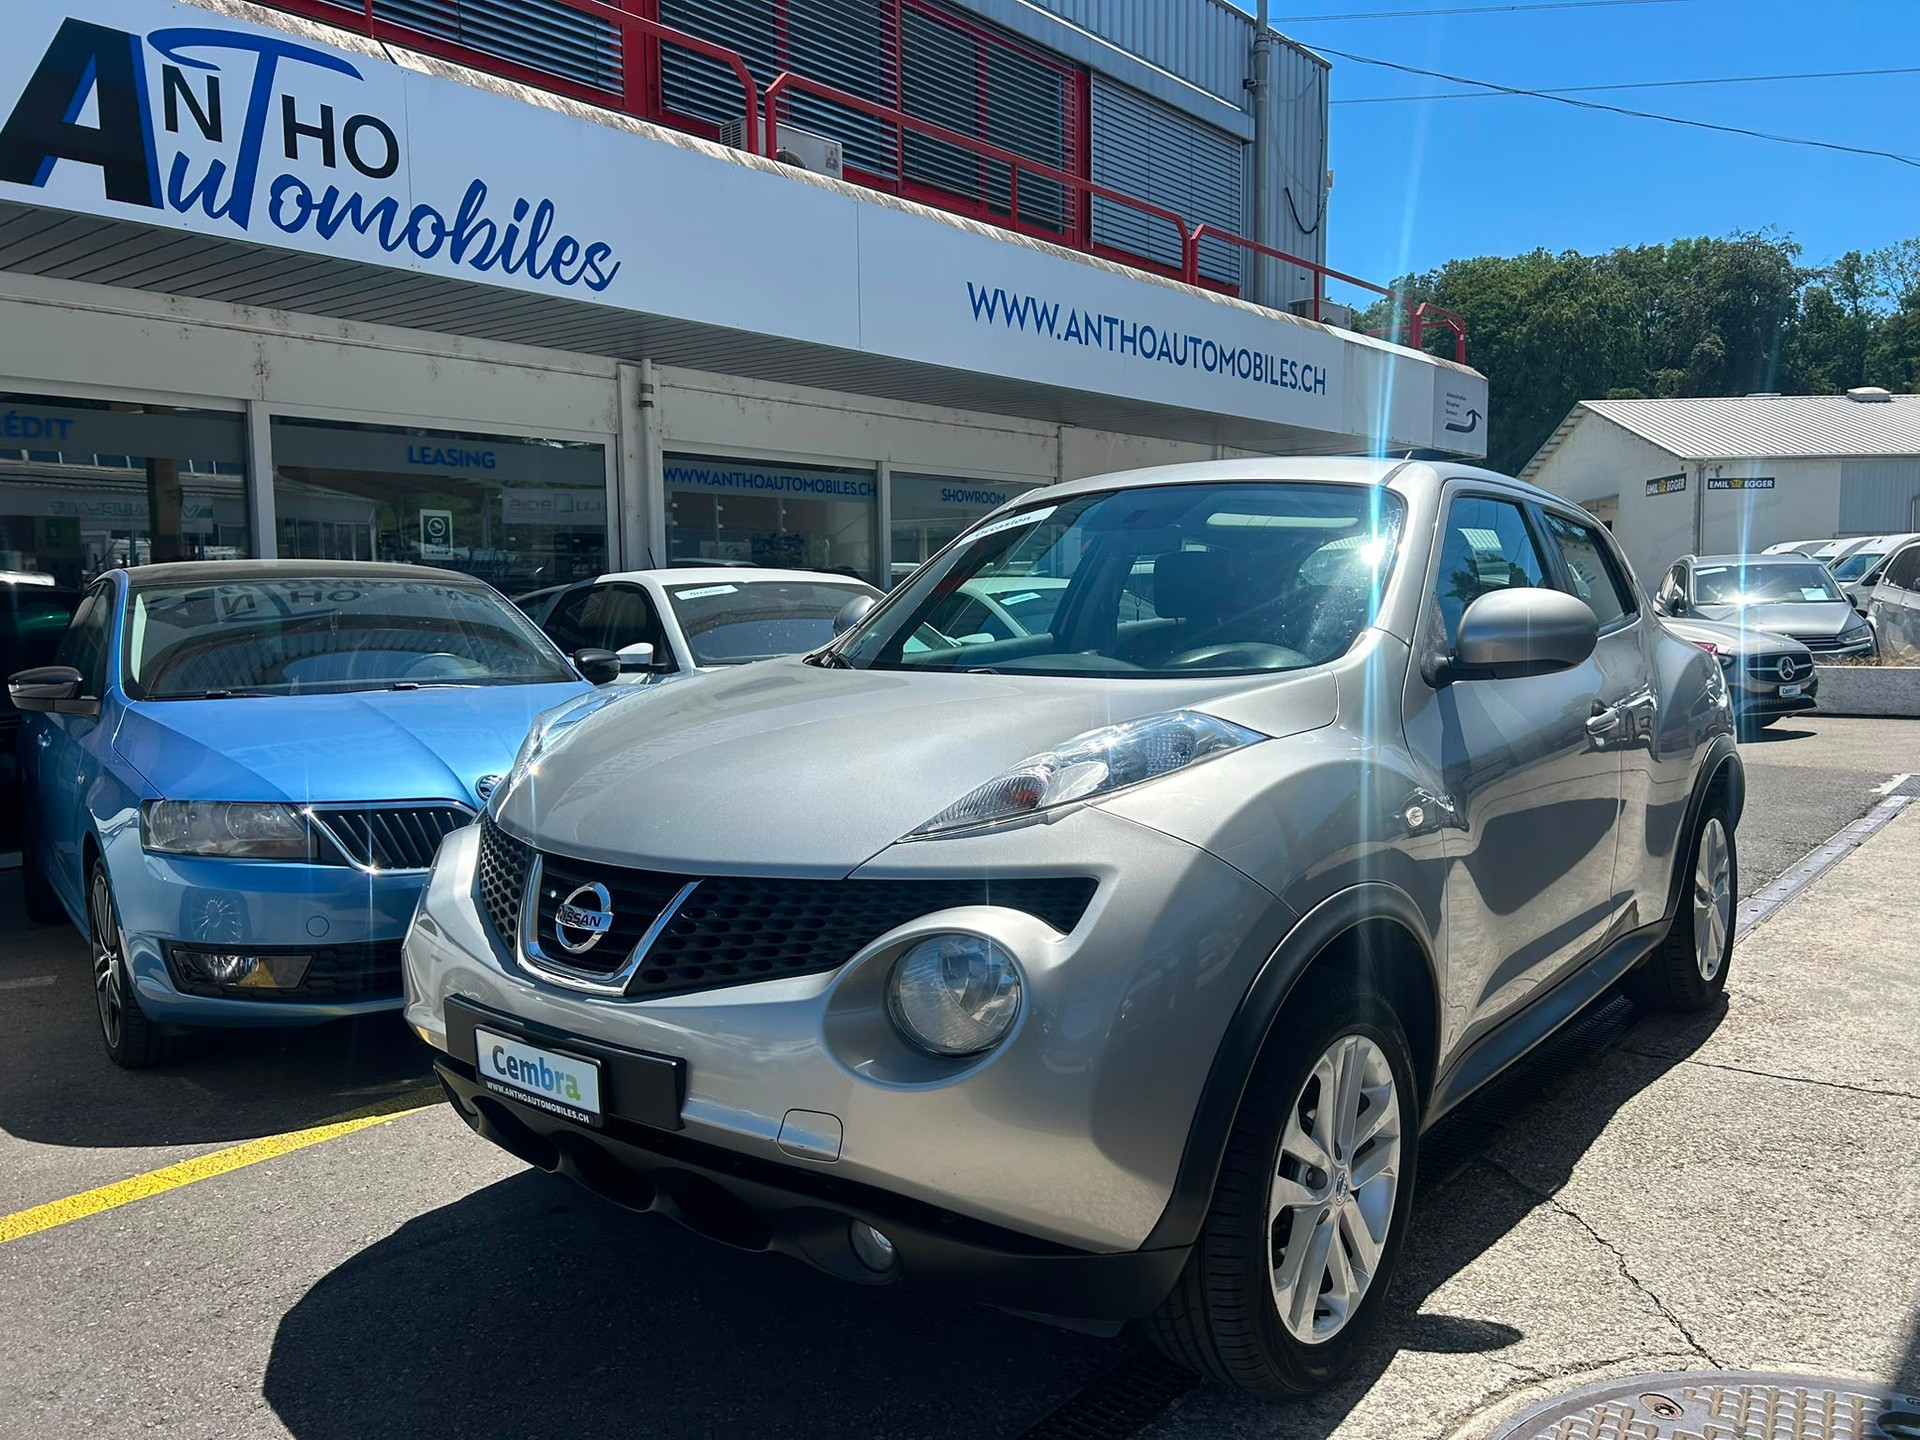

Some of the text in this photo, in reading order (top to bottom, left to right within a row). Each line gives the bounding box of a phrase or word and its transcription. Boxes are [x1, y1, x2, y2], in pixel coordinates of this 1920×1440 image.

[967, 281, 1326, 396] WWW.ANTHOAUTOMOBILES.CH
[0, 410, 74, 441] ÉDIT
[408, 446, 496, 469] LEASING
[942, 487, 1006, 505] SHOWROOM
[1709, 480, 1773, 489] EMIL EGGER
[558, 905, 602, 927] NISSAN
[492, 1045, 581, 1101] Cembra
[486, 1080, 590, 1124] WWW.ANTHOAUTOMOBILES.CH
